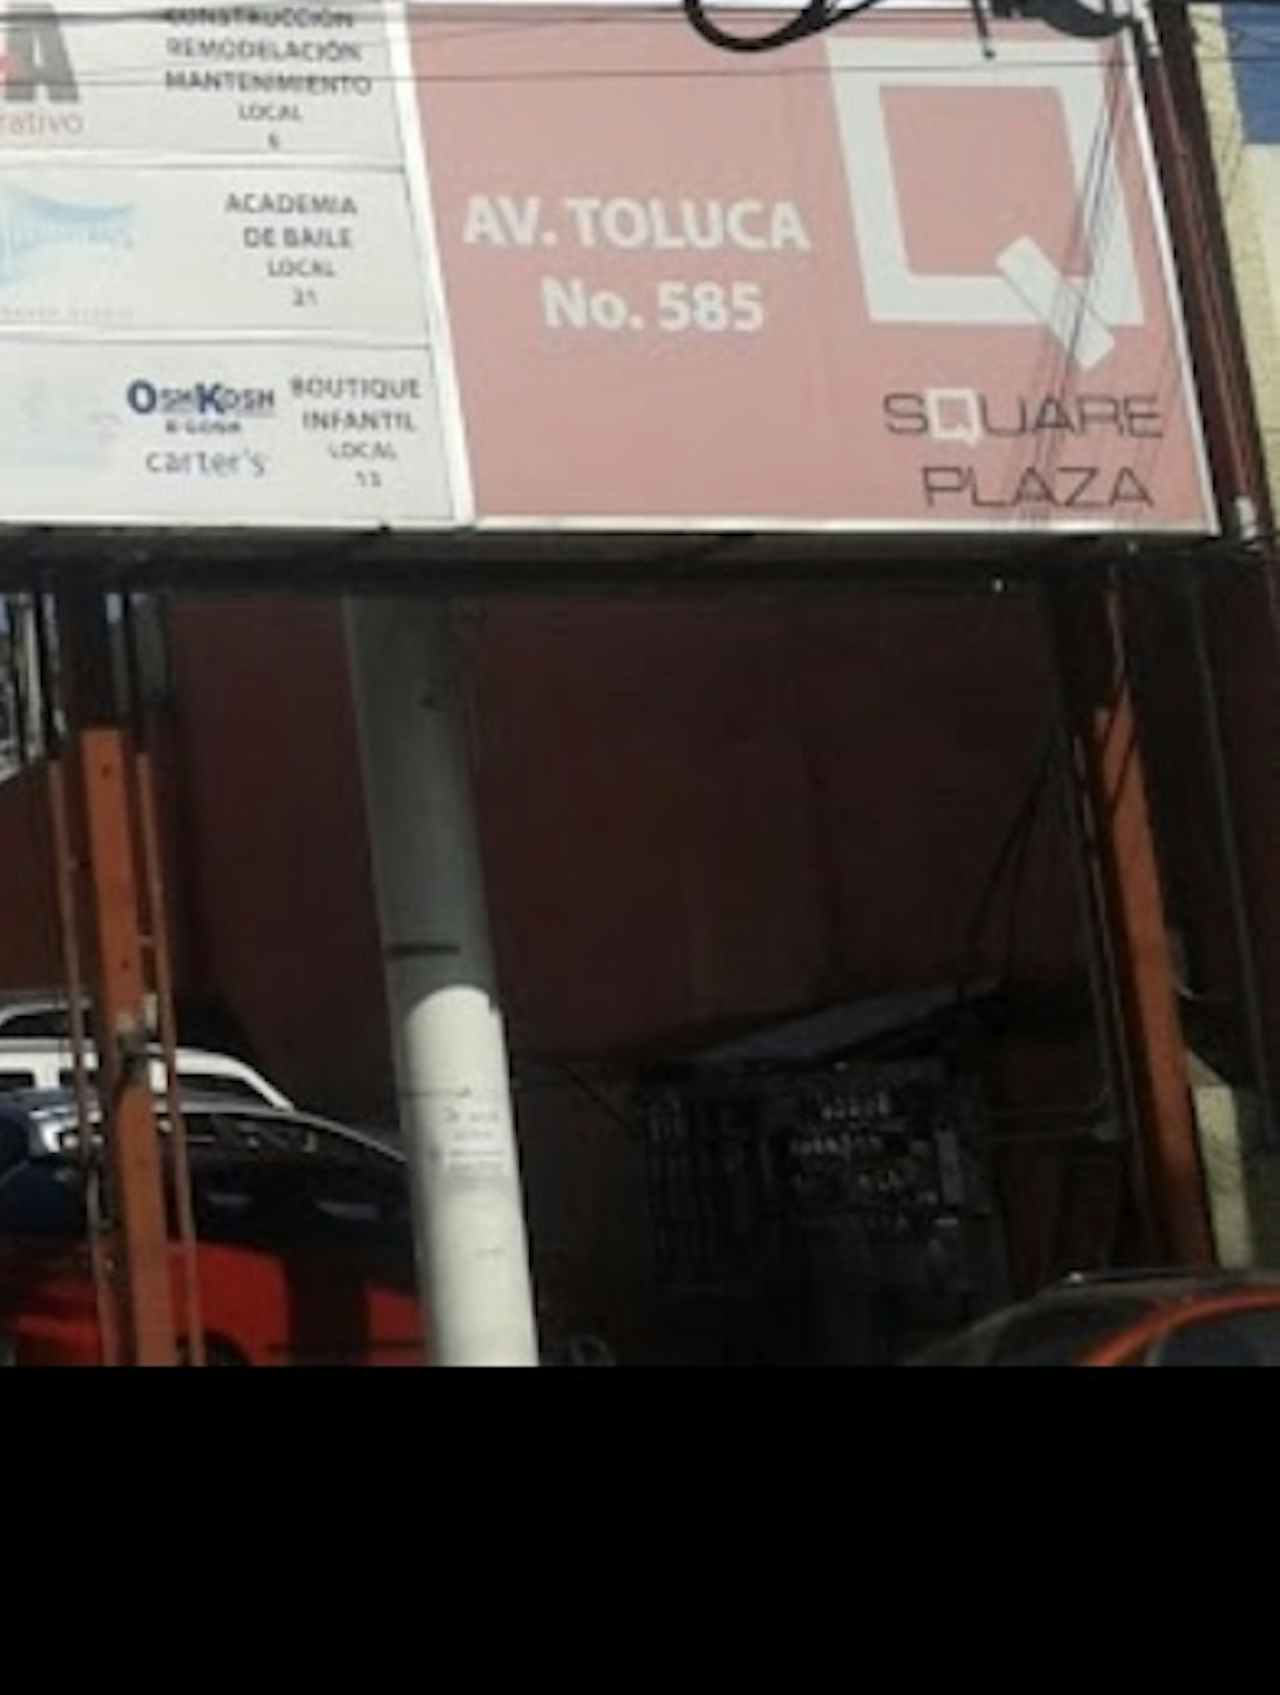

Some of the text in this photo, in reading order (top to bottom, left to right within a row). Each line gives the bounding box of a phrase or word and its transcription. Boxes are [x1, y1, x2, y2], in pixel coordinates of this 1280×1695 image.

[166, 36, 362, 64] REMODELACIÓN
[165, 70, 372, 96] MANTENIMIENTO
[238, 105, 302, 122] LOCAL
[224, 192, 358, 216] ACADEMIA
[462, 195, 811, 252] AV. TOLUCA
[243, 226, 354, 250] DE BAILE
[266, 258, 336, 279] LOCAL
[541, 277, 766, 334] No. 585
[290, 375, 421, 401] BOUTIQUE
[301, 409, 417, 433] INFANTIL
[882, 387, 1165, 448] SQUARE
[146, 446, 265, 478] carter's
[329, 441, 398, 461] LOCAL
[922, 465, 1154, 508] PLAZA
